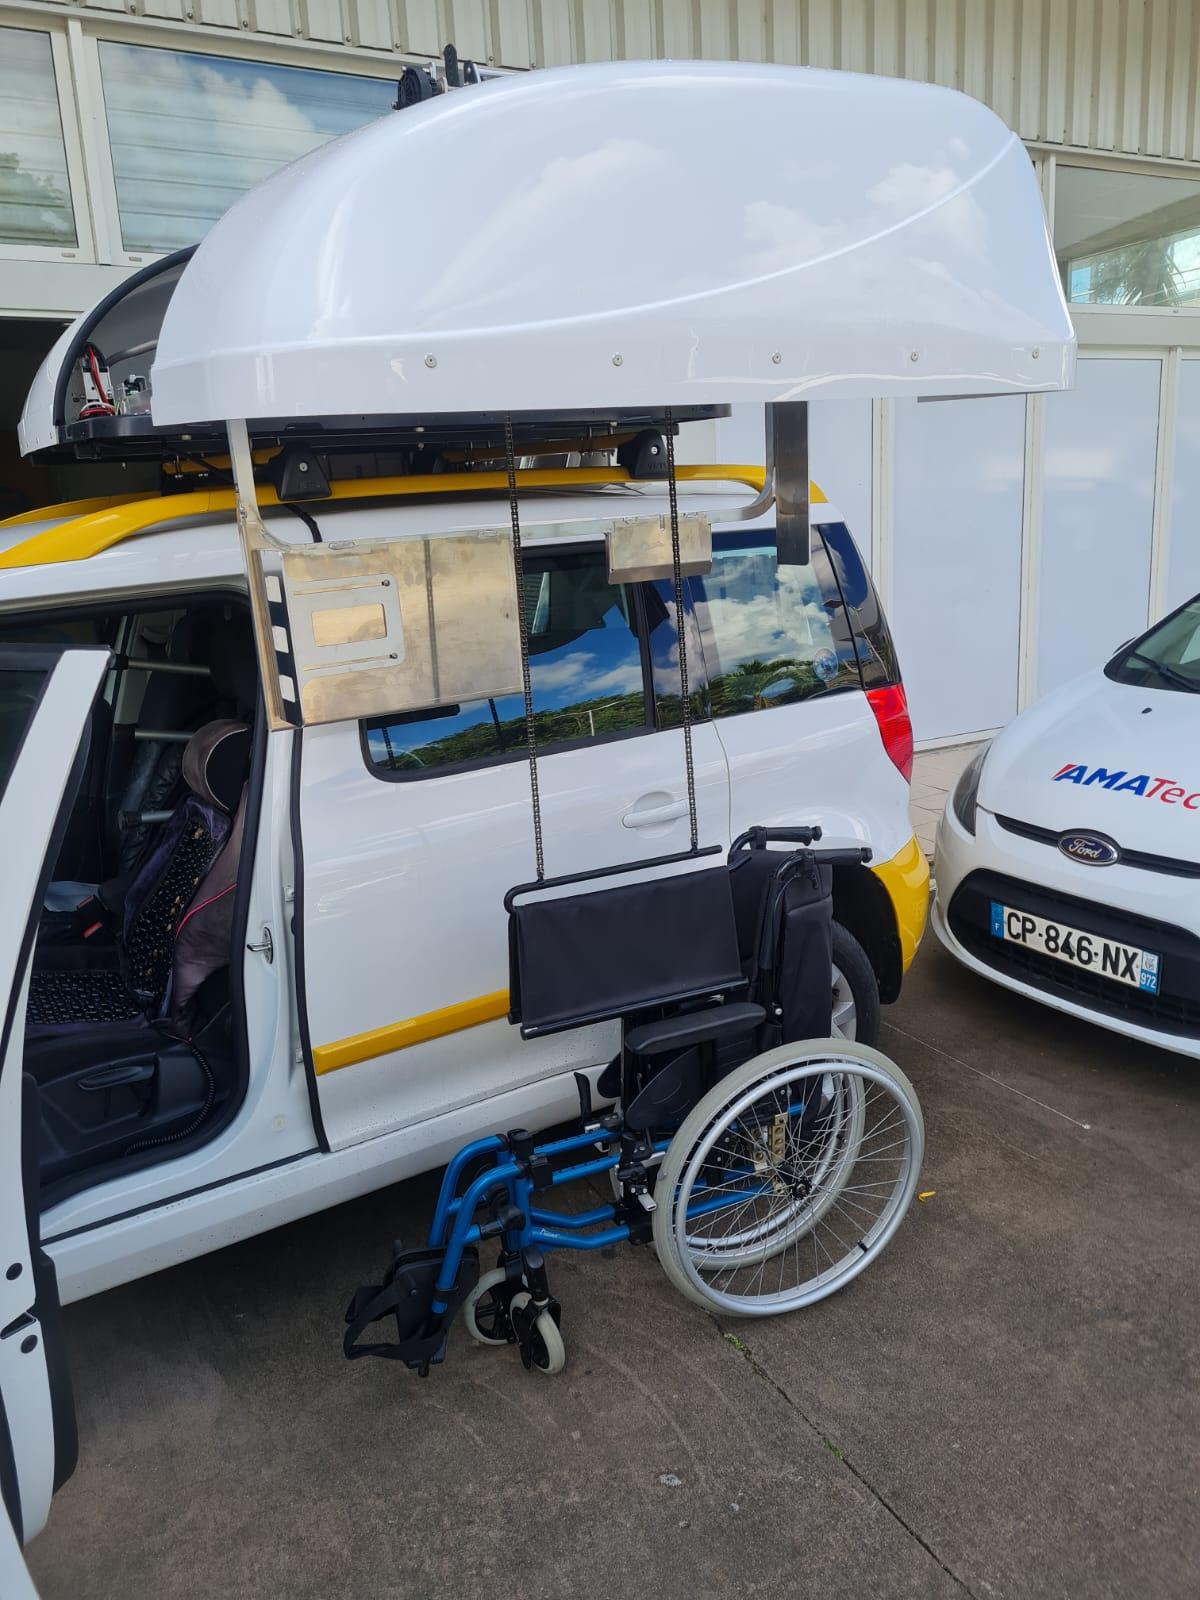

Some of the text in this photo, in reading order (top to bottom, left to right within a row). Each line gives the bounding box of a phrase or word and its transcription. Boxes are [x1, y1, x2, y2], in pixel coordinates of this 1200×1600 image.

[1068, 838, 1103, 859] Ford
[1007, 912, 1139, 982] CP-846-NX
[1141, 972, 1157, 989] 972
